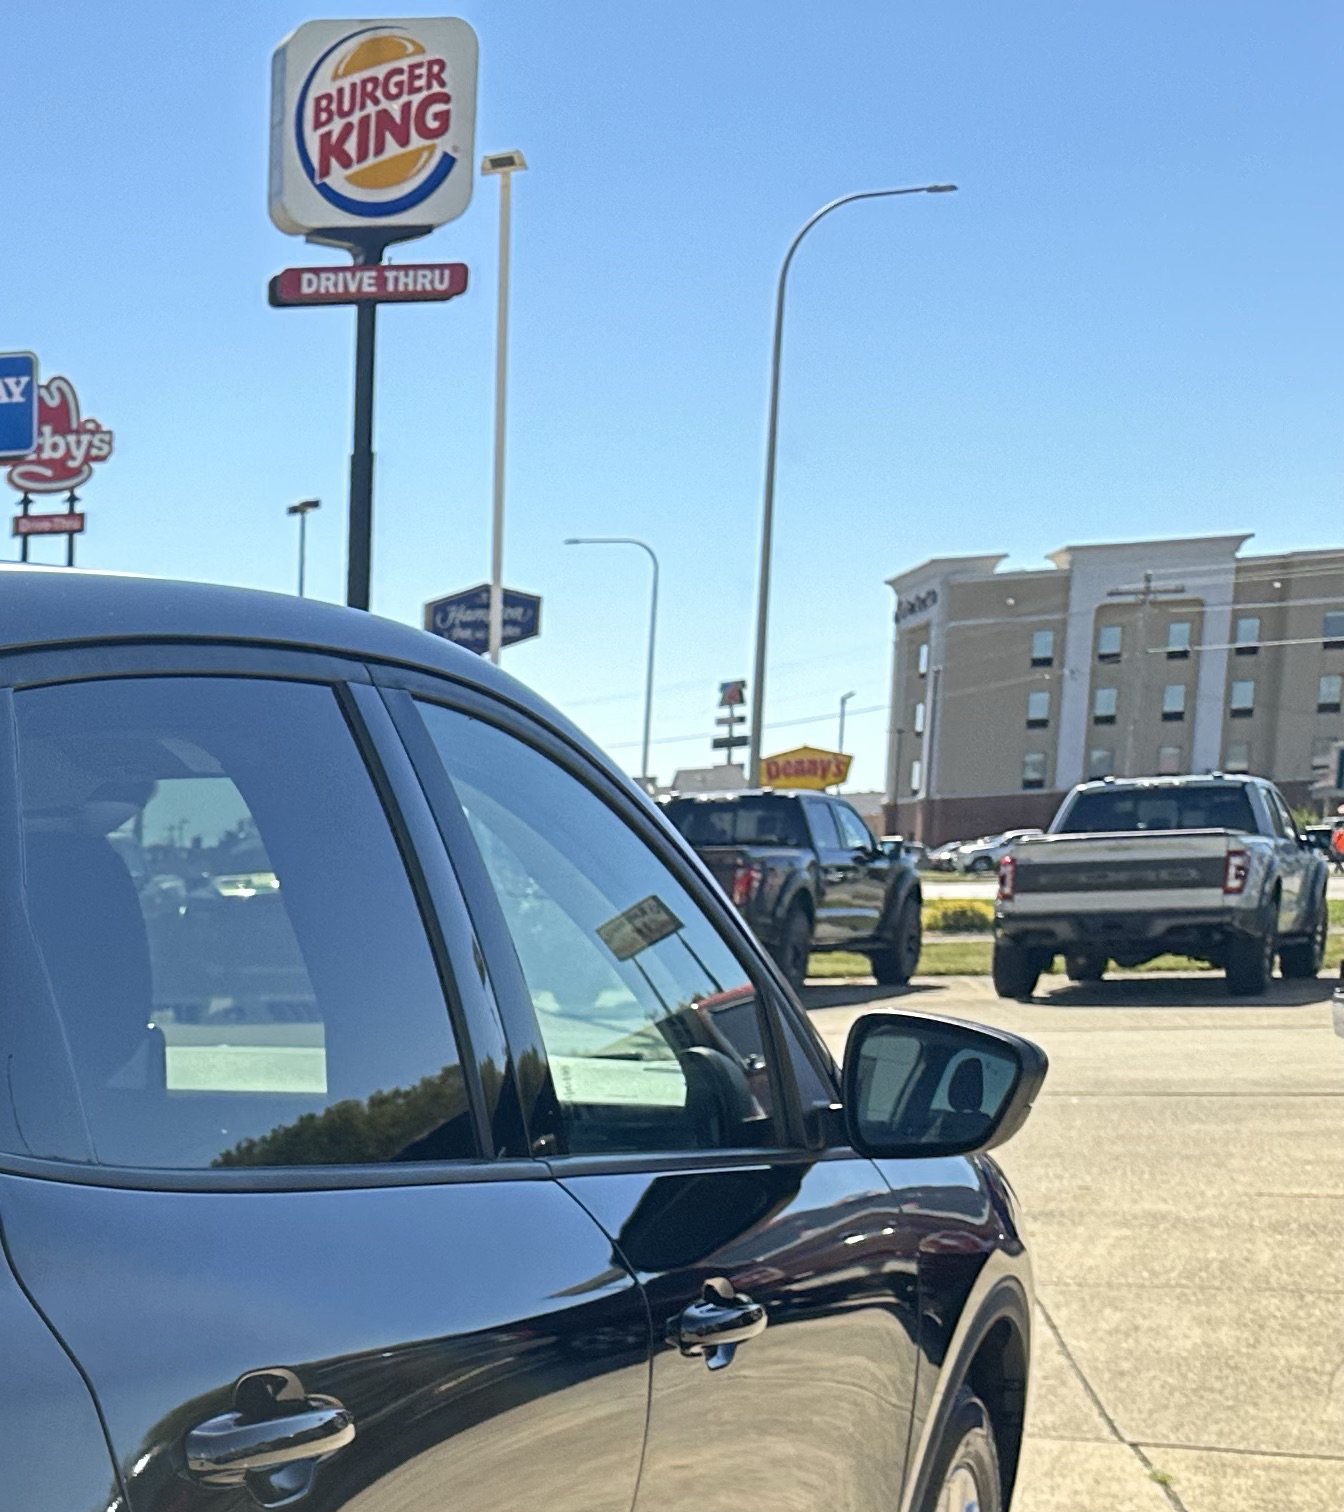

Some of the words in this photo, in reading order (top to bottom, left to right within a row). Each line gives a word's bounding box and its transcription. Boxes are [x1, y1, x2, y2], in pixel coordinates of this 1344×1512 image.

[313, 58, 447, 131] BURGER
[319, 91, 451, 180] KING
[301, 270, 378, 294] DRIVE
[384, 269, 451, 291] THRU
[765, 753, 846, 781] Denny's
